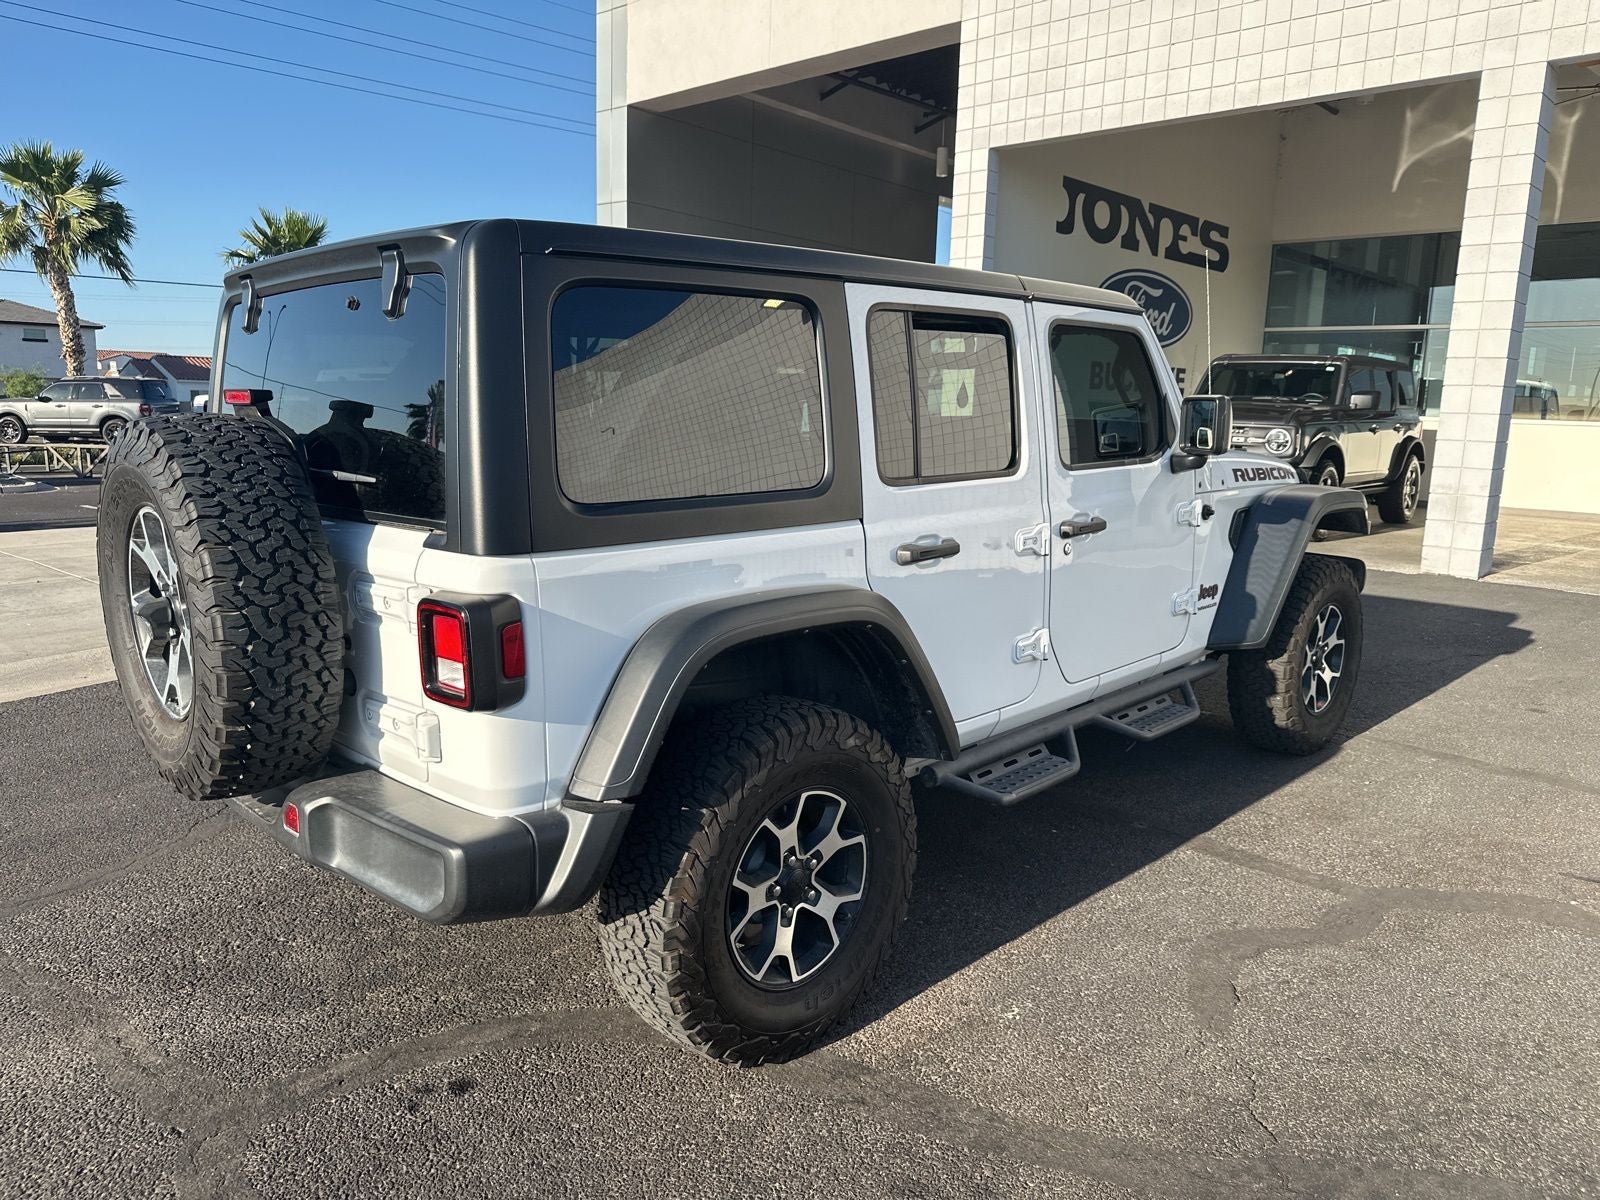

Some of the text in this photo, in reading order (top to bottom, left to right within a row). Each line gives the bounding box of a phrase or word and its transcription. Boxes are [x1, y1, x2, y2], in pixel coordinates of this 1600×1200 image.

[1056, 175, 1230, 273] JONES
[1123, 280, 1177, 336] Frd
[1231, 467, 1296, 482] RUBICON
